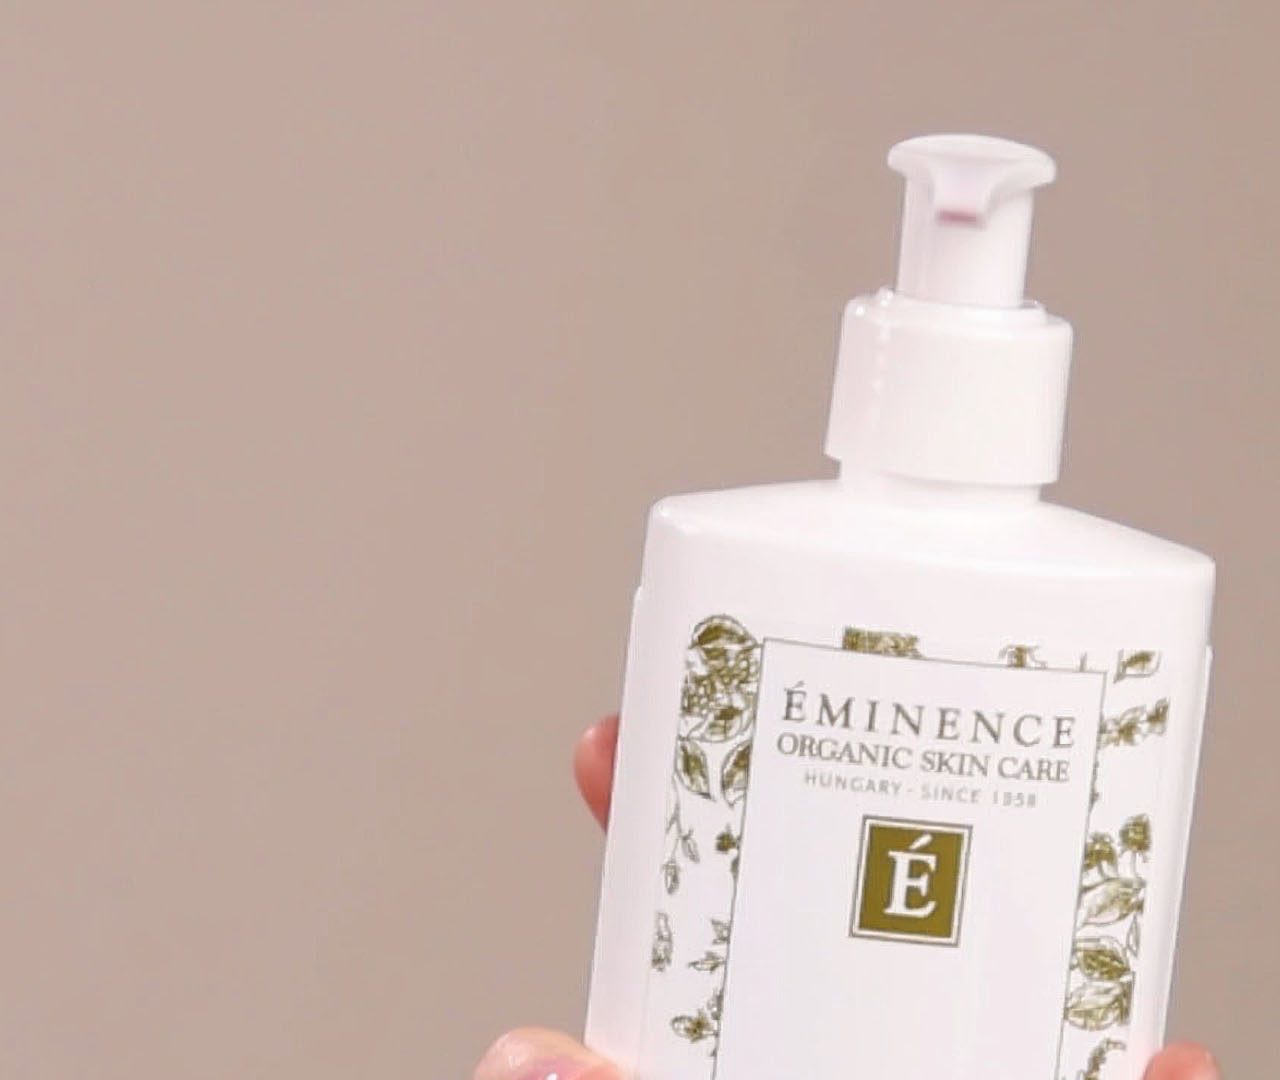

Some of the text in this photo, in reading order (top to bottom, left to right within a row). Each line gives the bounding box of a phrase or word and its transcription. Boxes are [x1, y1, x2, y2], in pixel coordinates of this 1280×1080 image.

[783, 681, 1075, 748] ÉMINENCE
[777, 732, 1070, 782] ORGANIC SKIN CARE
[804, 773, 902, 796] HUNGARY
[921, 785, 980, 805] SINCE
[884, 834, 936, 918] É
